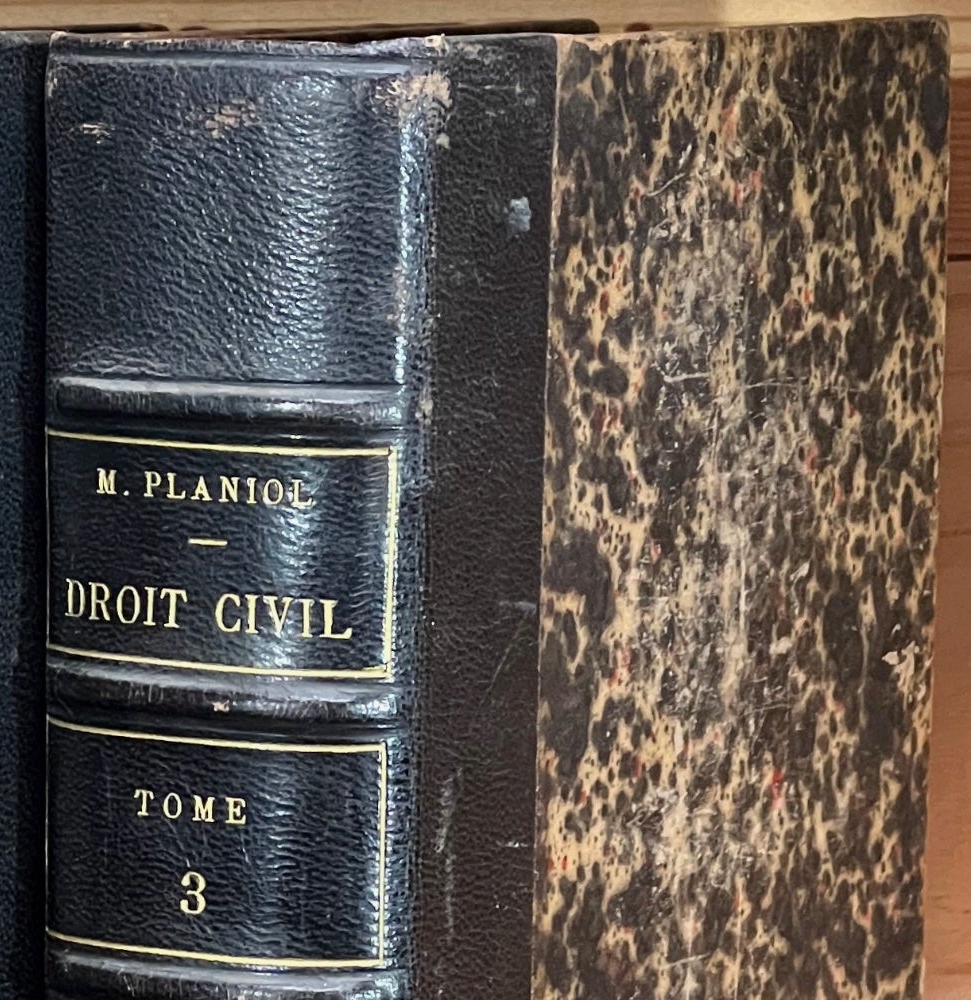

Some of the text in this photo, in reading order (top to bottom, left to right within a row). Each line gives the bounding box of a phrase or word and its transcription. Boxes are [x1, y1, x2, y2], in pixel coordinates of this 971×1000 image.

[96, 467, 314, 508] M. PLANIOL
[64, 578, 353, 641] DROIT CIVIL
[133, 788, 247, 825] TOME
[179, 870, 207, 916] 3
